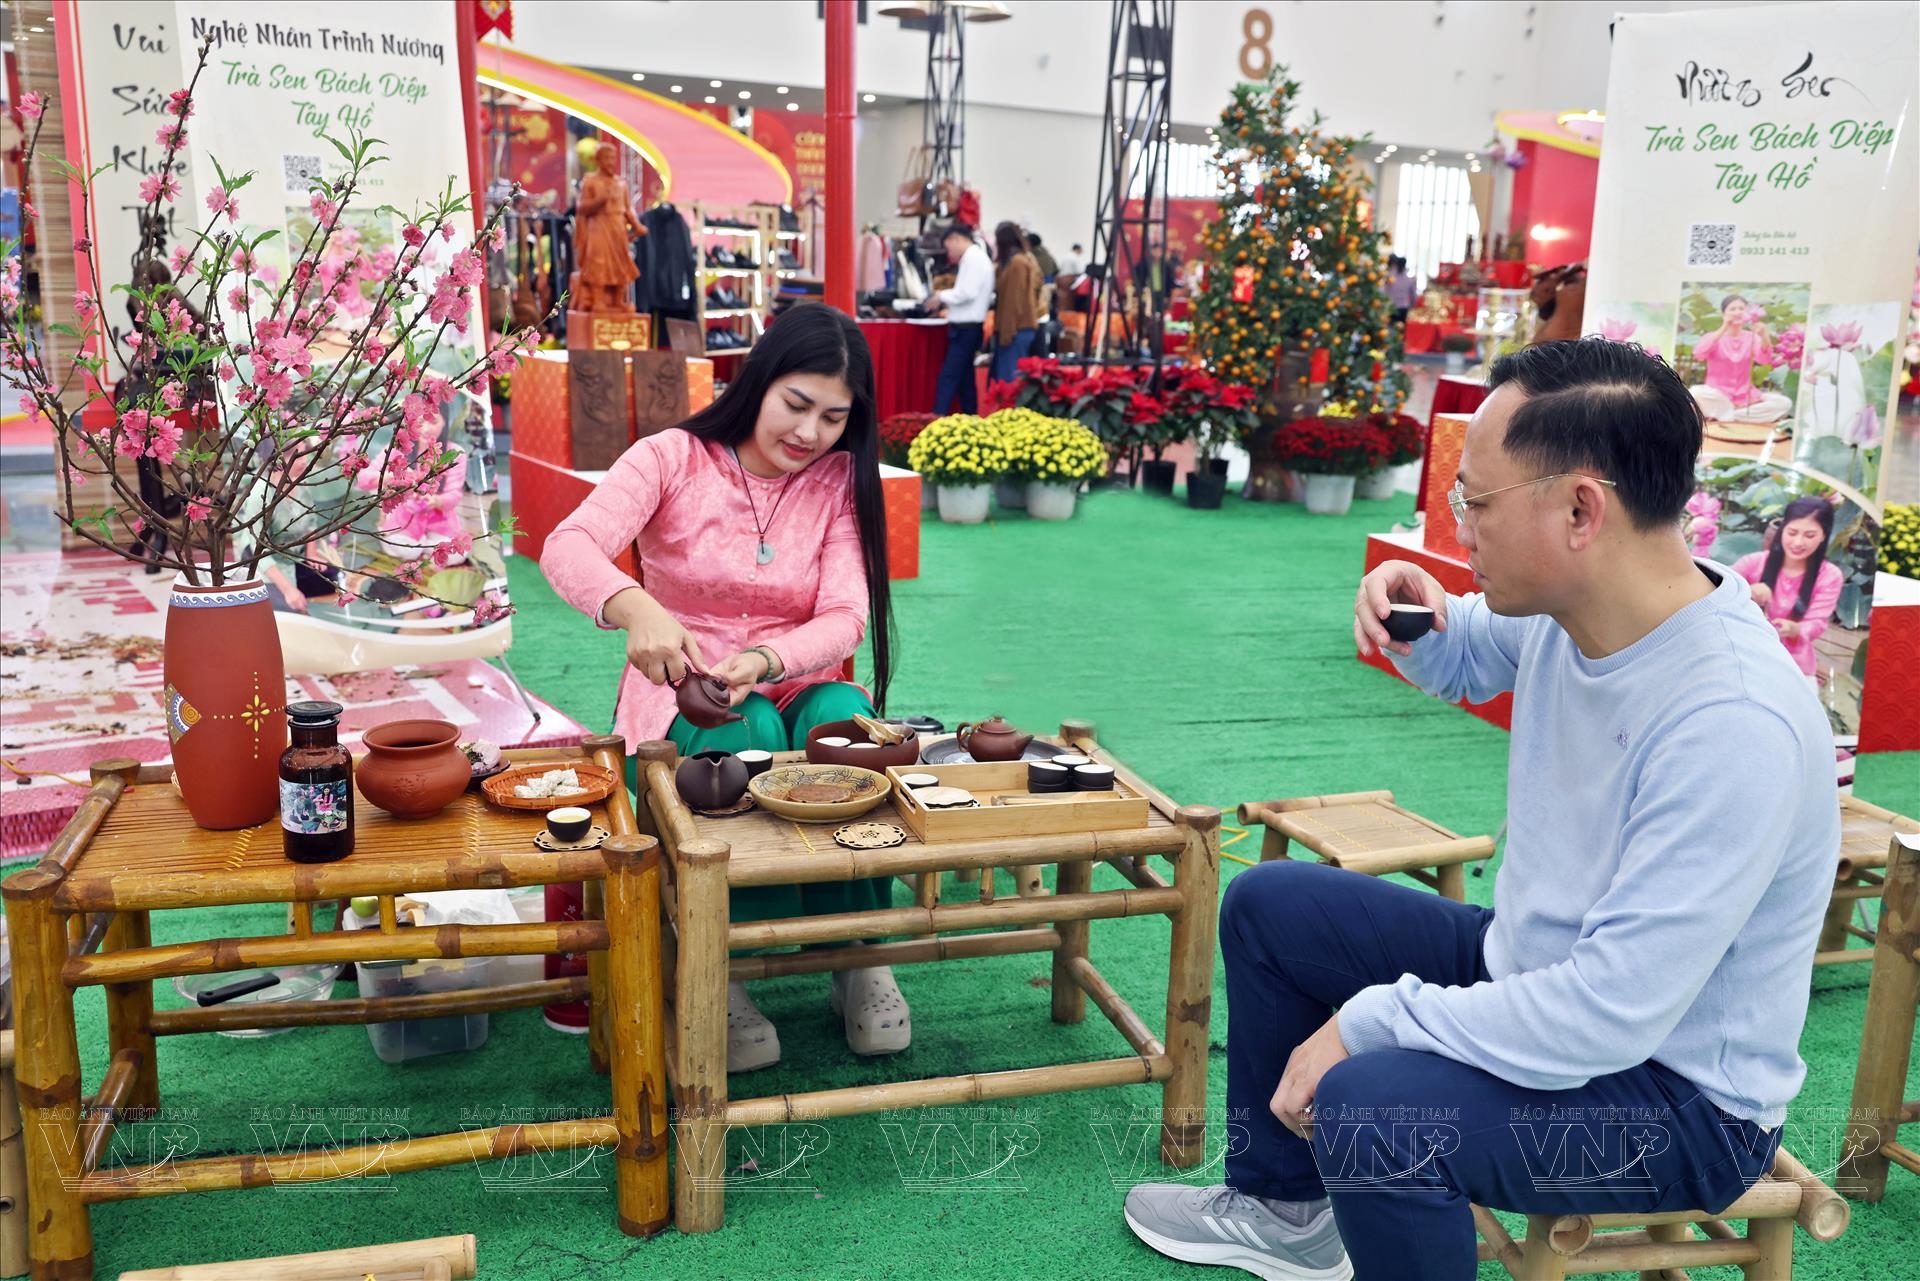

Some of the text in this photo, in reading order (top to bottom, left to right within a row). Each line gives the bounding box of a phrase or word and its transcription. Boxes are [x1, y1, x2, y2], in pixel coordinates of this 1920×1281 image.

[113, 23, 168, 53] Vui
[191, 17, 248, 48] Nghệ
[1240, 9, 1273, 80] 8
[222, 60, 429, 104] Trà Sen Bách Diệp
[291, 100, 375, 138] Tây Hồ
[1645, 119, 1895, 154] Trà Sen Bách Diệp
[1714, 156, 1818, 203] Tây Hồ
[121, 204, 185, 239] Tt
[1769, 247, 1787, 256] 141
